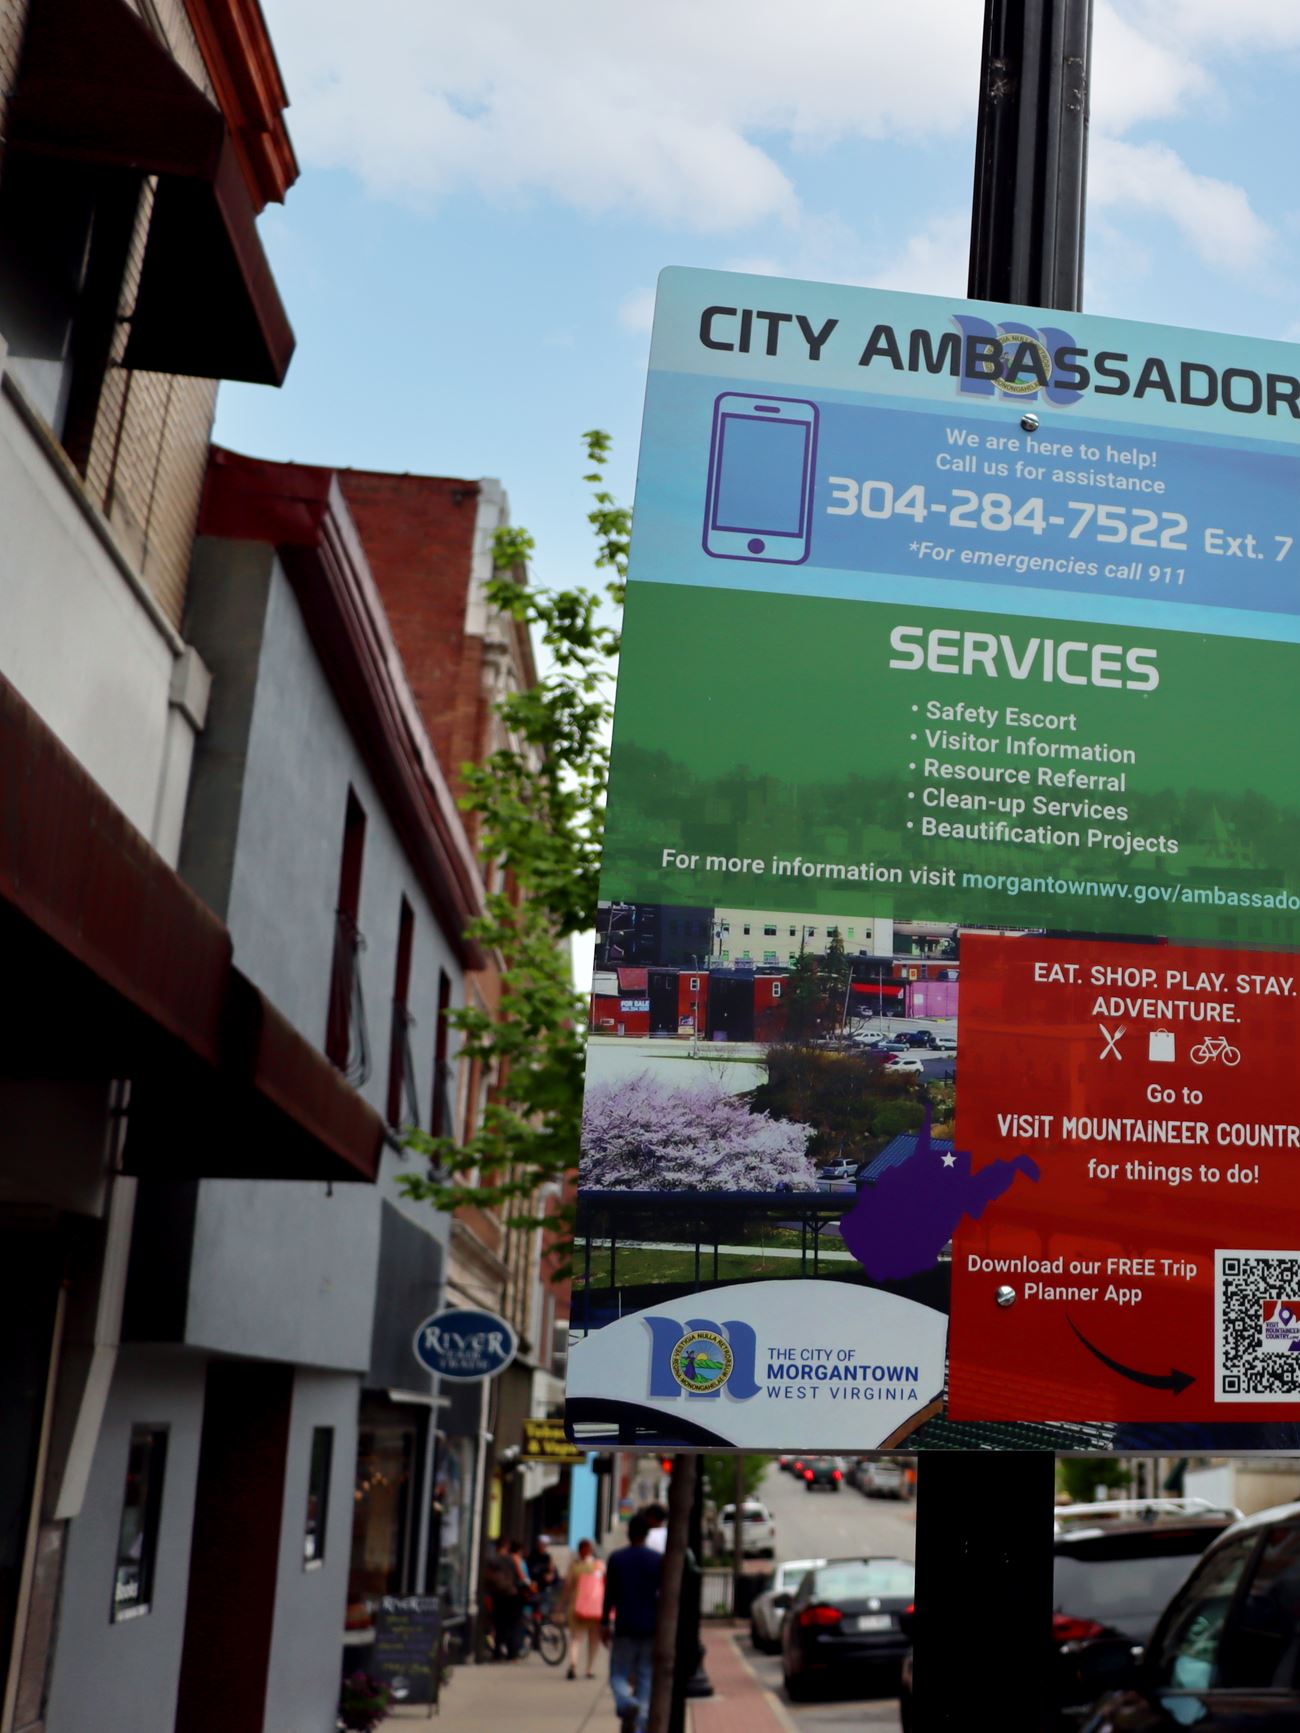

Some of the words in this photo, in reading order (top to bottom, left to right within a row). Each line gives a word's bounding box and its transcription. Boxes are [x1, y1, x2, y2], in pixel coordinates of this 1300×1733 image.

[699, 305, 840, 361] CITY
[945, 427, 980, 447] We
[985, 436, 1020, 452] are
[1026, 435, 1074, 458] here
[1079, 443, 1100, 461] to
[1106, 445, 1157, 470] help!
[935, 453, 977, 473] Call
[983, 461, 1009, 477] us
[1015, 460, 1047, 481] for
[1051, 469, 1166, 494] assistance
[826, 476, 1189, 552] 304-284-7522
[1204, 527, 1264, 559] Ext.
[1274, 535, 1293, 562] 7
[960, 549, 1099, 577] emergencies
[1104, 562, 1143, 581] call
[1148, 565, 1185, 585] 911
[889, 625, 1160, 691] SERVICES
[926, 700, 999, 729] Safety
[1005, 707, 1077, 731] Escort
[925, 729, 1000, 753] Visitor
[1006, 735, 1136, 765] Information
[924, 757, 1031, 785] Resource
[1037, 767, 1126, 792] Referral
[923, 787, 1026, 818] Clean-up
[1032, 795, 1129, 821] Services
[921, 816, 1080, 847] Beautification
[1087, 828, 1179, 855] Projects
[661, 848, 700, 869] For
[705, 855, 765, 874] more
[771, 855, 903, 883] information
[909, 865, 956, 887] visit
[1034, 962, 1082, 984] EAT.
[1090, 965, 1158, 989] SHOP.
[1166, 969, 1229, 993] PLAY.
[1236, 974, 1297, 997] STAY.
[1091, 996, 1241, 1023] ADVENTURE.
[1146, 1083, 1176, 1104] Go
[1181, 1086, 1203, 1105] to
[1087, 1158, 1120, 1179] for
[1125, 1159, 1193, 1186] things
[1199, 1164, 1221, 1183] to
[1226, 1163, 1259, 1184] do!
[967, 1254, 1063, 1274] Download
[1069, 1261, 1102, 1275] our
[1107, 1258, 1155, 1276] FREE
[1159, 1259, 1197, 1281] Trip
[1024, 1281, 1099, 1301] Planner
[1103, 1284, 1143, 1306] App
[767, 1347, 797, 1362] THE
[800, 1348, 833, 1361] CITY
[836, 1349, 856, 1362] OF
[767, 1363, 919, 1382] MORGANTOWN
[766, 1385, 819, 1399] WEST
[829, 1386, 918, 1401] VIRGINIA
